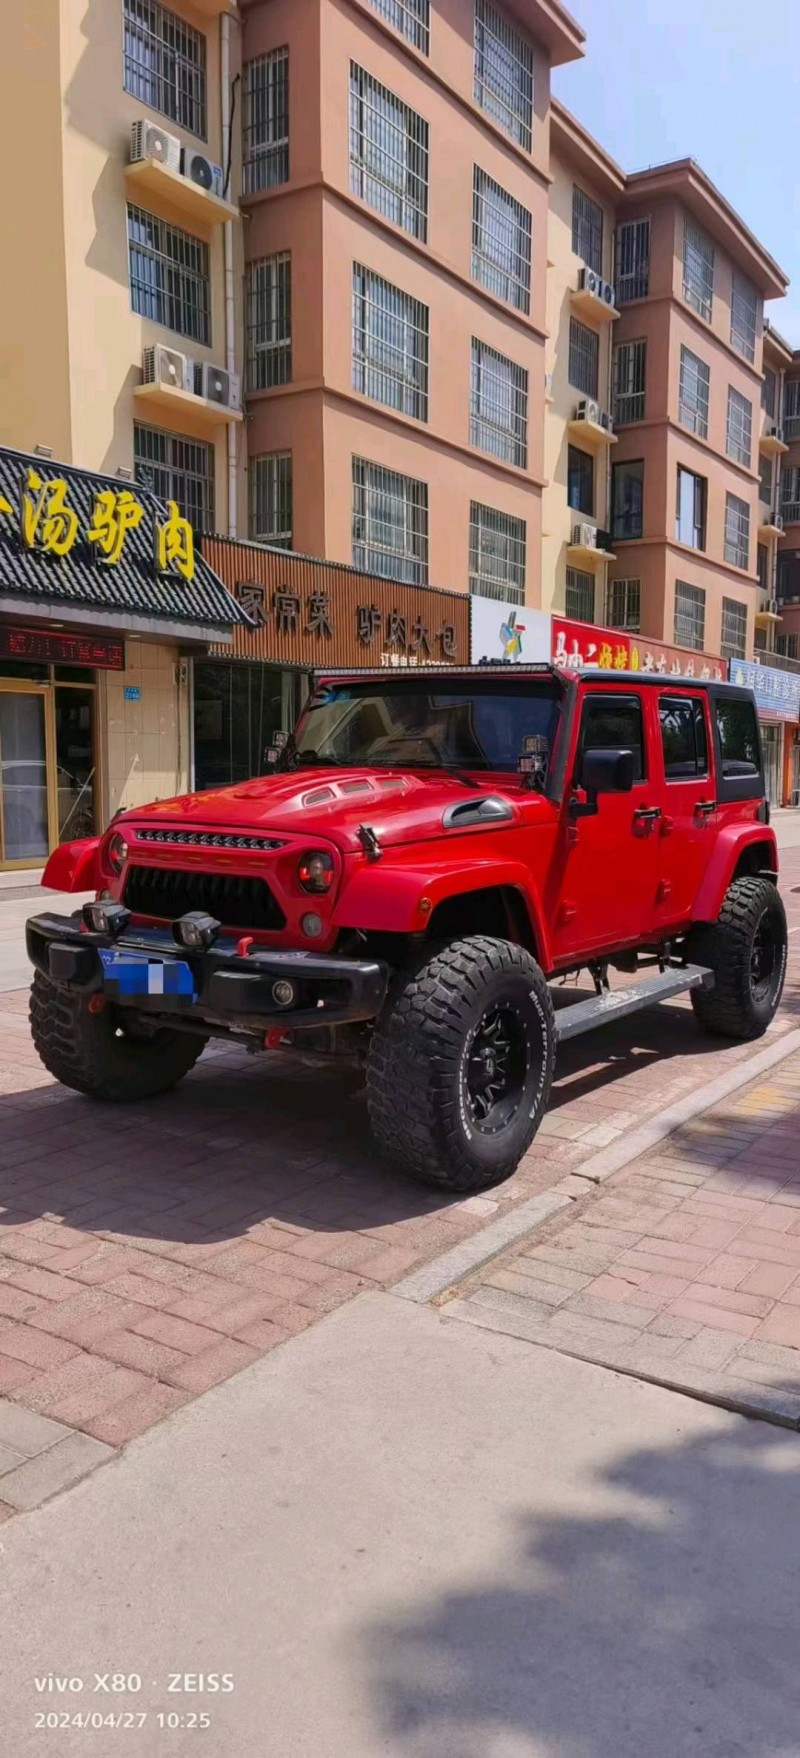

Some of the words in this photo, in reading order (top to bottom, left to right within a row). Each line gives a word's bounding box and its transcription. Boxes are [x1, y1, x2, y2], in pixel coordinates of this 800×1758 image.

[0, 467, 195, 581] 汤驴肉
[235, 578, 334, 638] 家常菜
[356, 603, 459, 659] 驴肉大包
